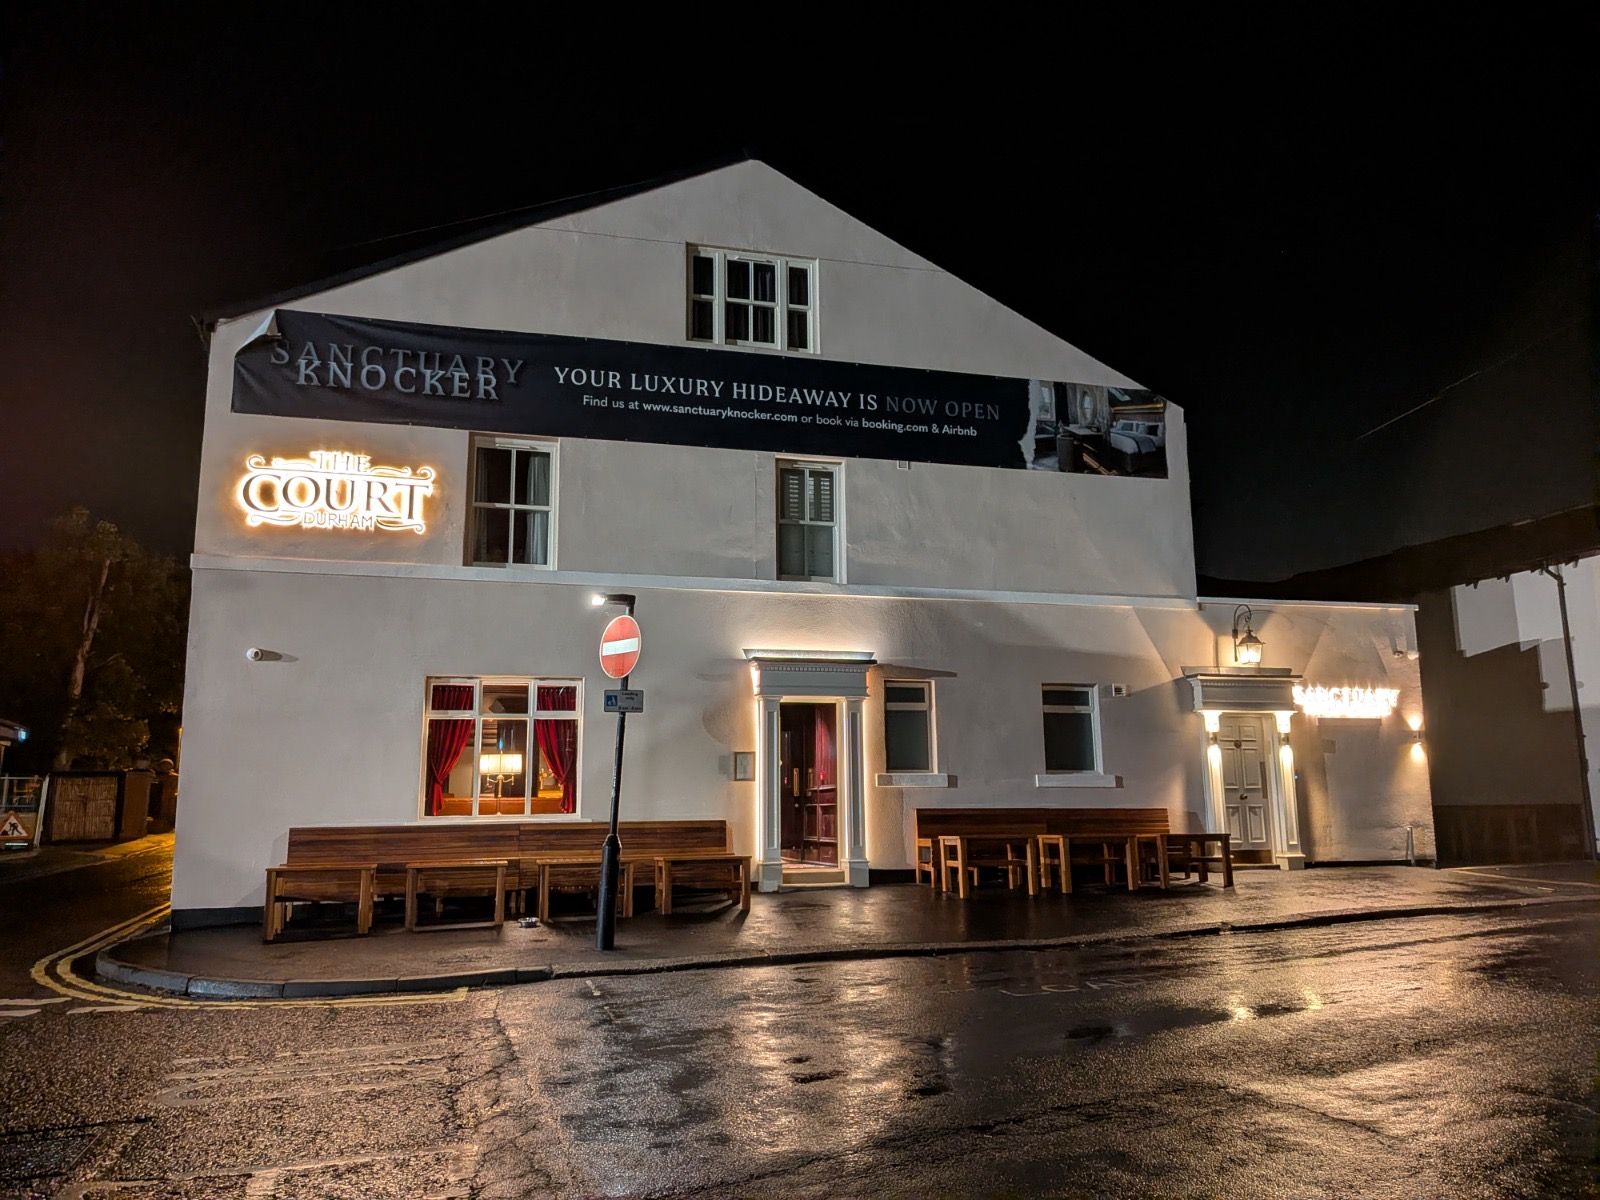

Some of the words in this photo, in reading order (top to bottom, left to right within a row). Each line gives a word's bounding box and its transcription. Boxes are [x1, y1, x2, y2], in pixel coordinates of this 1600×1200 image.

[270, 340, 524, 384] SANCTUARY
[296, 359, 499, 400] KNOCKER
[554, 366, 622, 389] YOUR
[630, 373, 725, 398] LUXURY
[732, 382, 851, 409] HIDEAWAY
[858, 393, 878, 411] IS
[886, 395, 938, 416] NOW
[945, 400, 1000, 420] OPEN
[583, 394, 608, 408] Find
[612, 399, 625, 409] us
[628, 399, 639, 410] at
[642, 401, 798, 423] www.sanctuaryknocker.com
[801, 415, 813, 424] or
[816, 414, 842, 426] book
[845, 417, 859, 428] via
[861, 418, 929, 433] booking.com
[931, 423, 940, 434] &
[942, 424, 978, 437] Airbnb
[314, 452, 371, 472] THE
[242, 473, 430, 520] COURT
[303, 511, 374, 530] DURHAM
